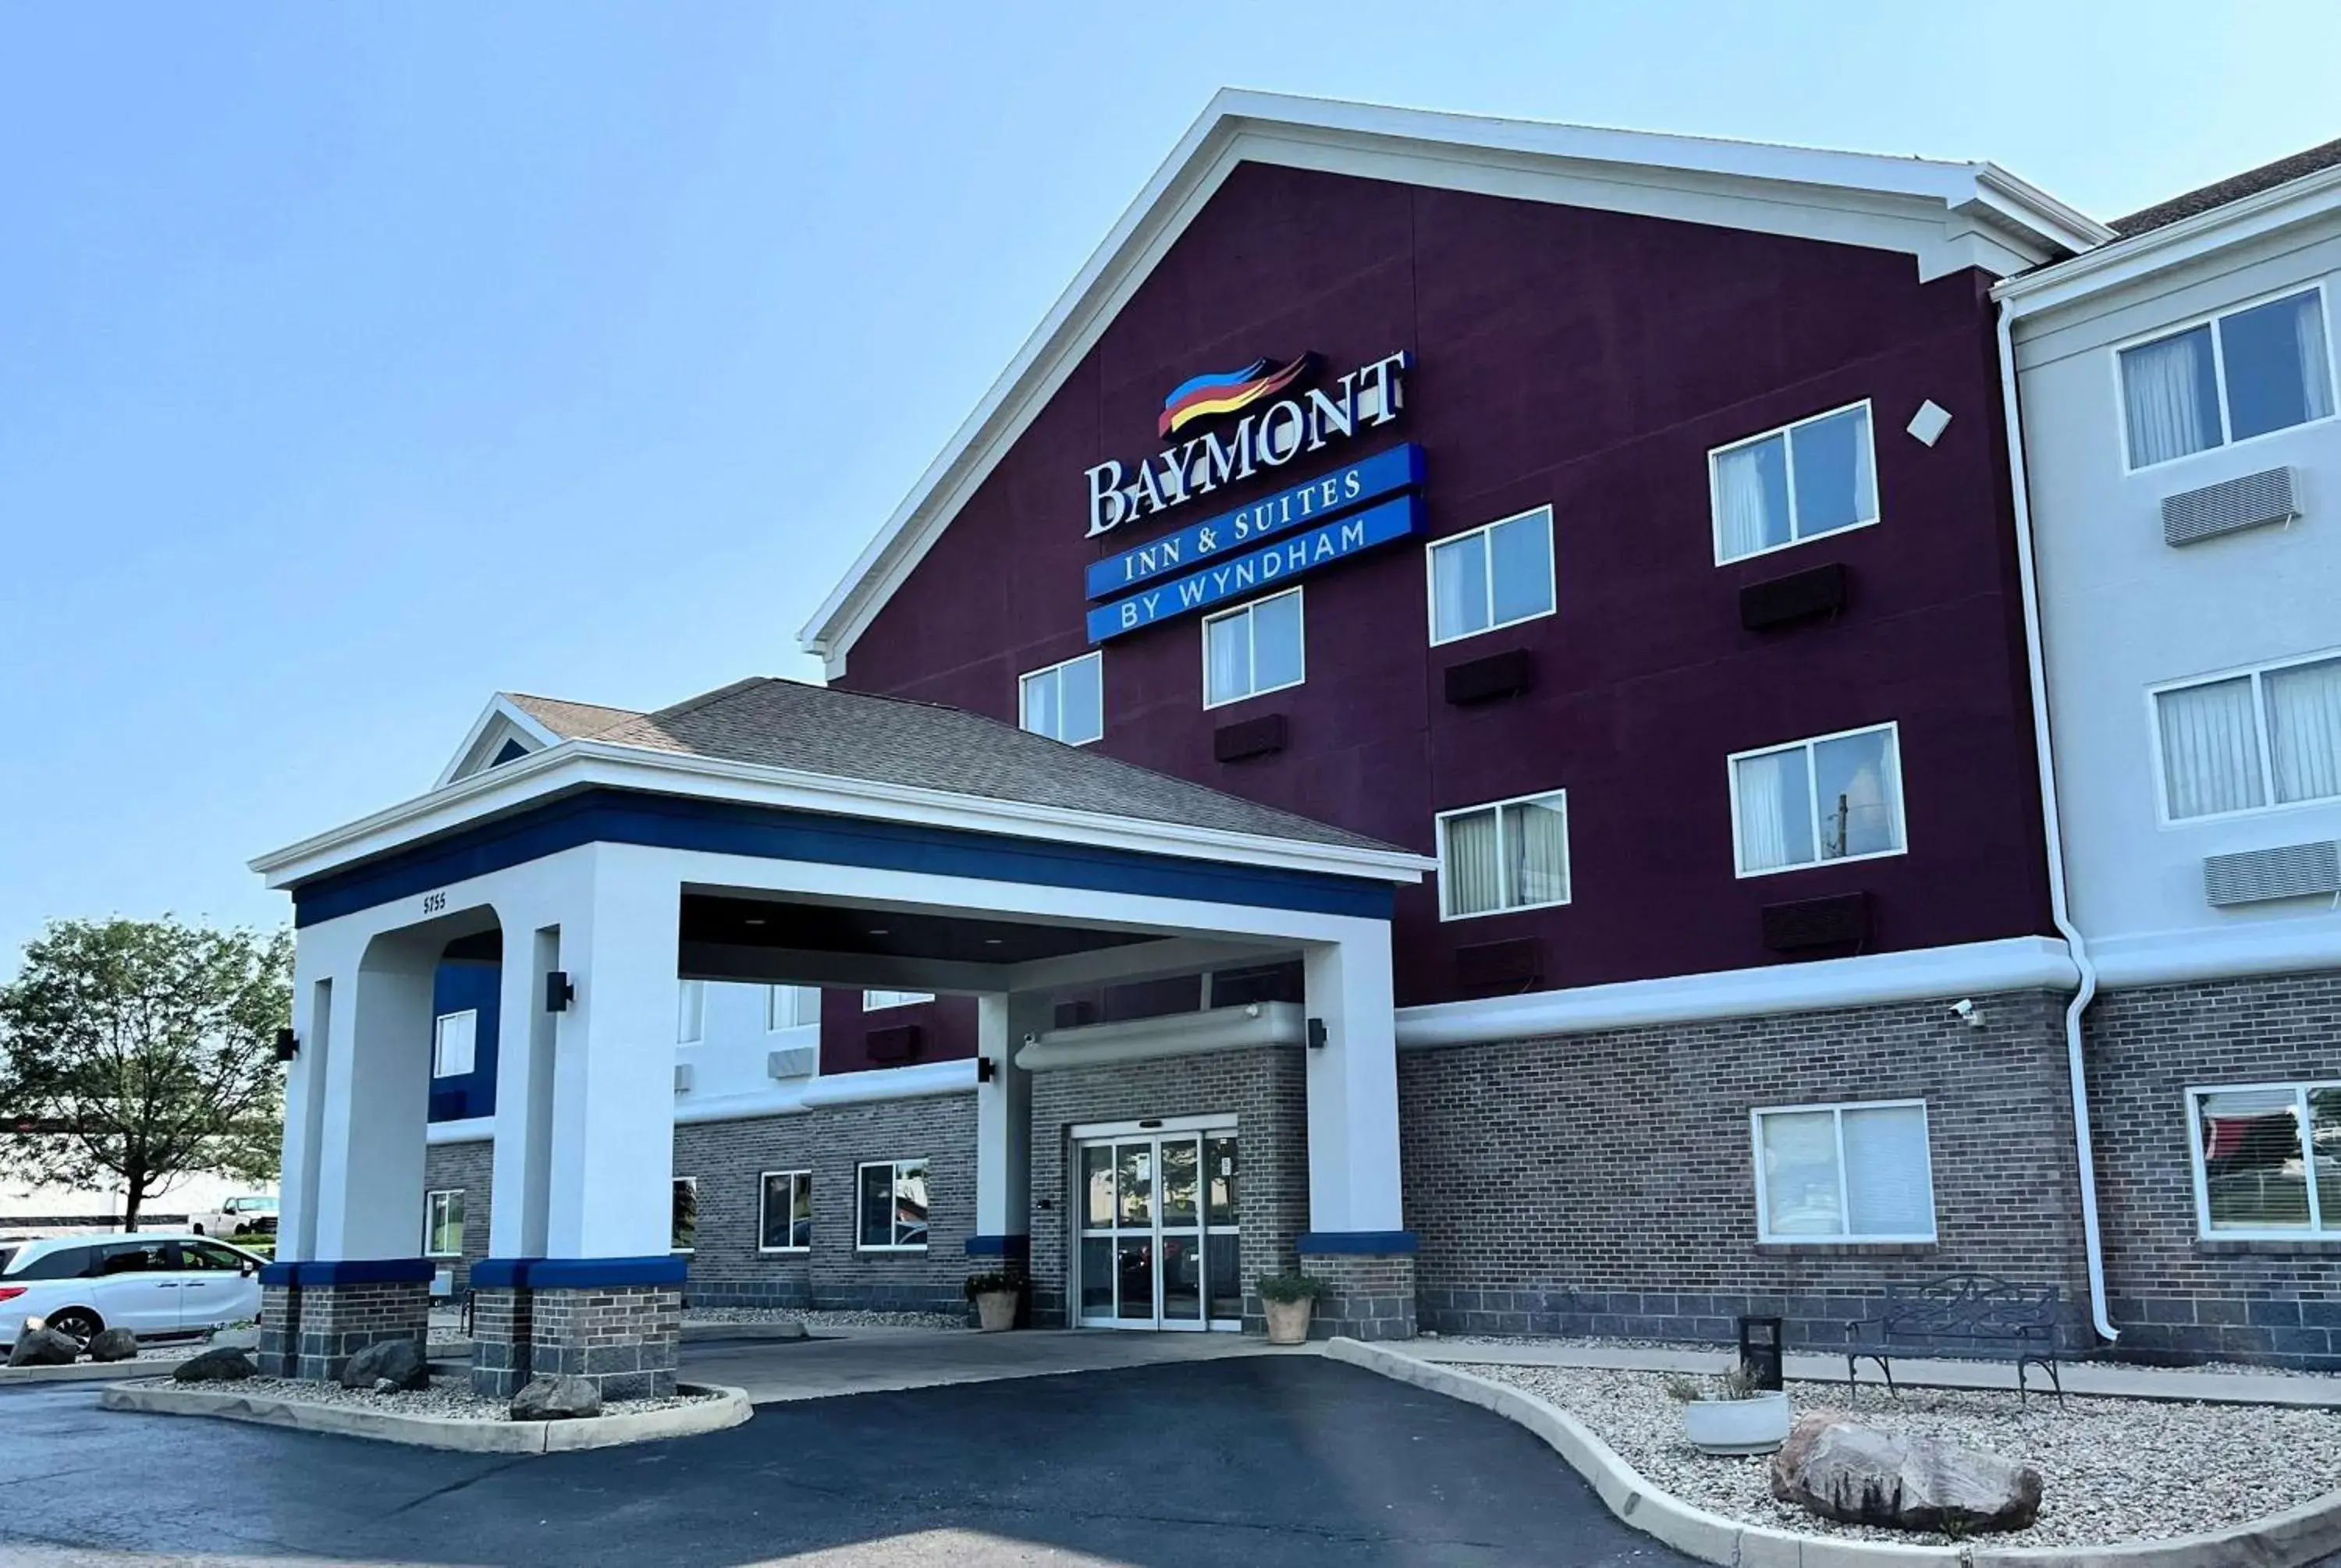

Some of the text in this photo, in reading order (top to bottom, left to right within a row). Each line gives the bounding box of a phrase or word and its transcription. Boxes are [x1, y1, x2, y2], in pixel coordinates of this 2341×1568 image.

[1085, 349, 1406, 538] BAYMONT
[1121, 520, 1364, 629] BY WYNDHAM
[1124, 470, 1362, 581] INN & SUITES
[424, 892, 446, 914] 5755
